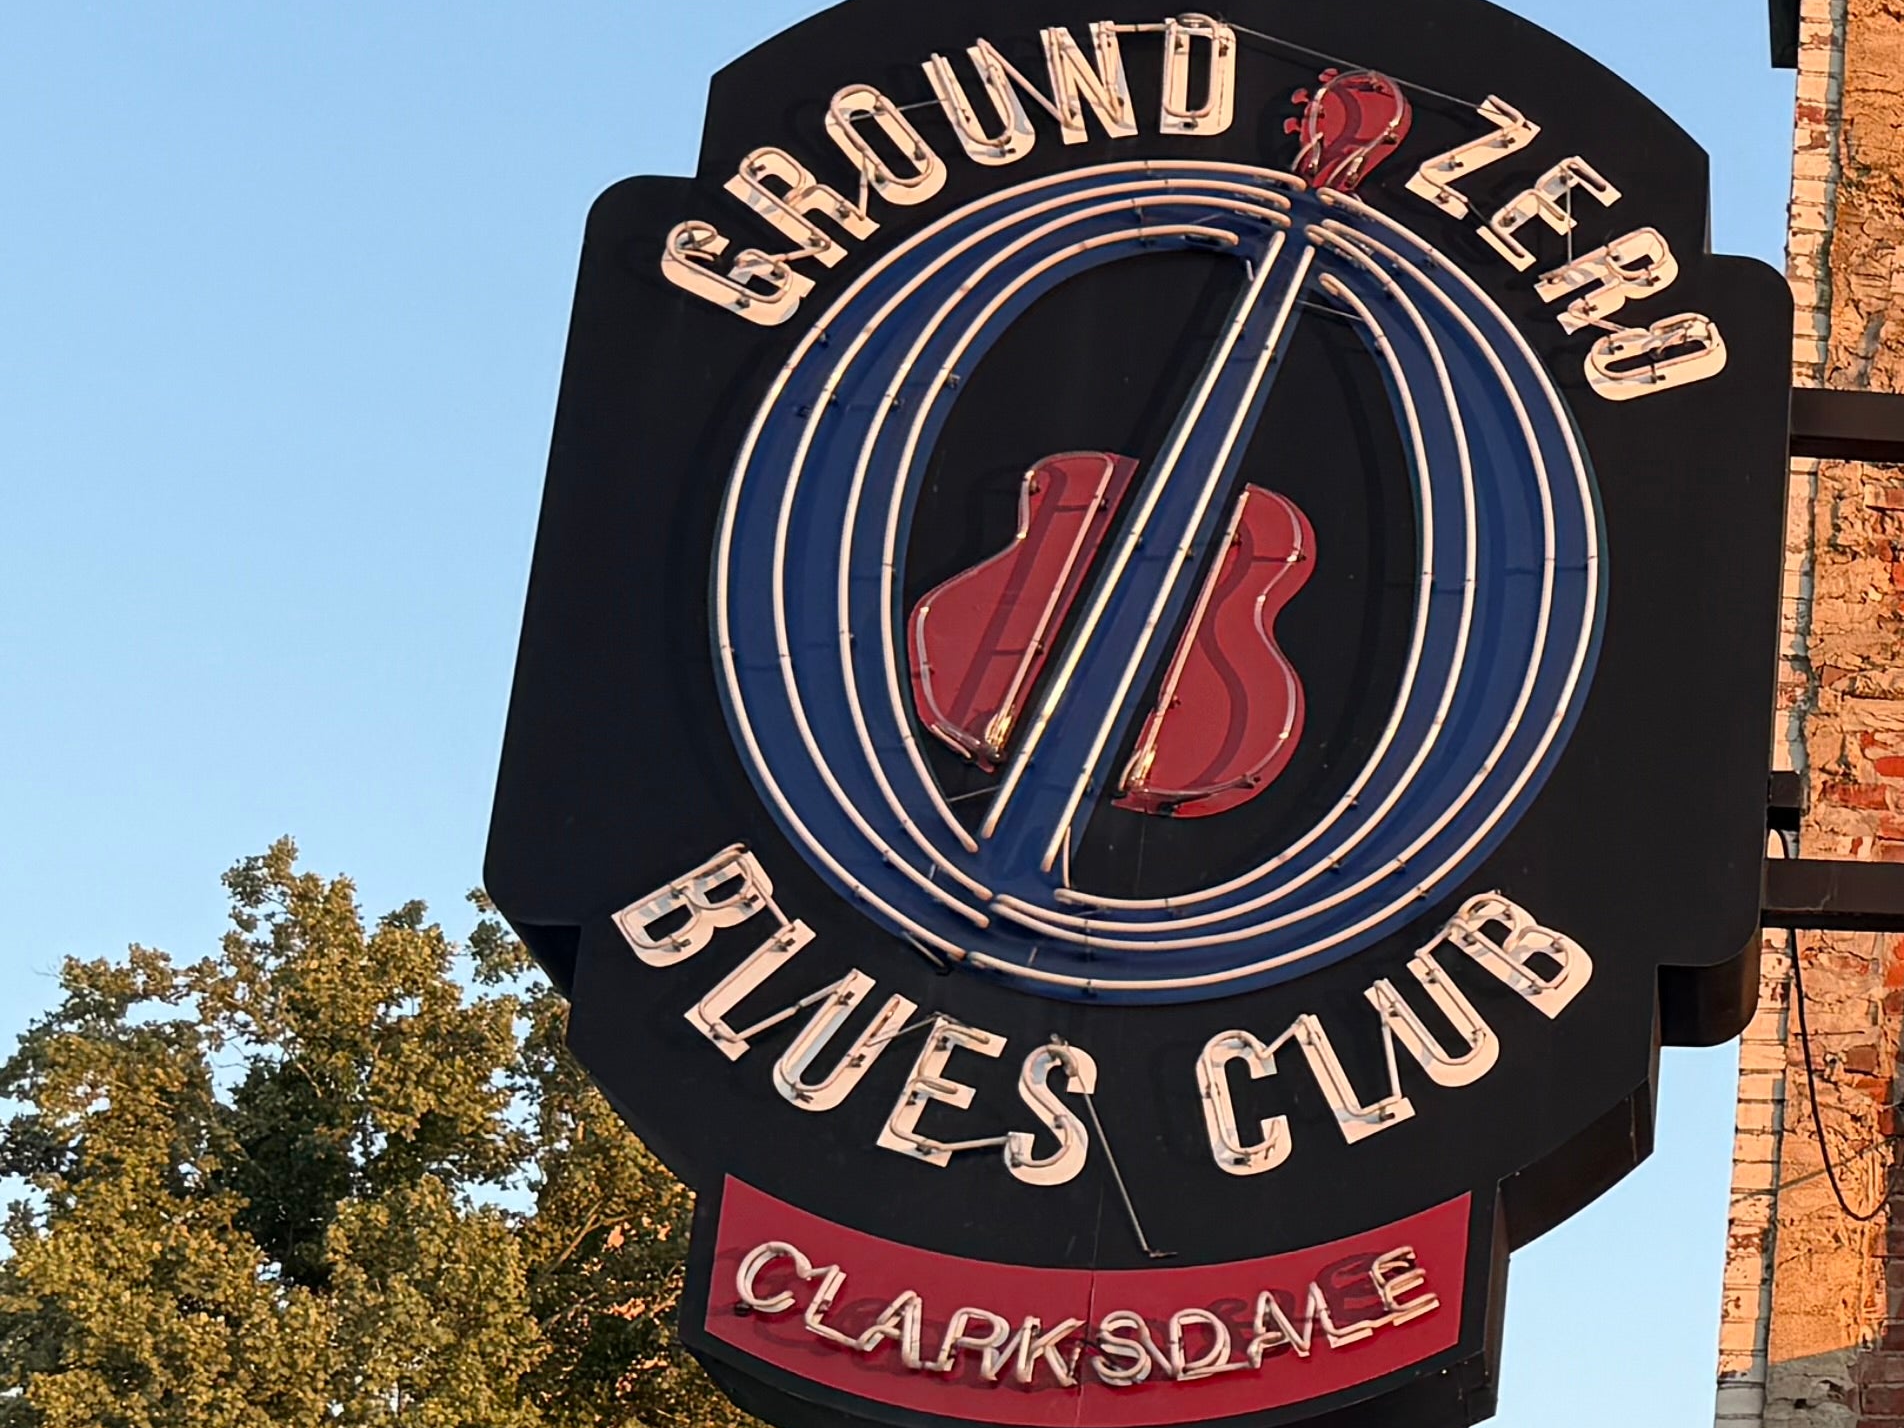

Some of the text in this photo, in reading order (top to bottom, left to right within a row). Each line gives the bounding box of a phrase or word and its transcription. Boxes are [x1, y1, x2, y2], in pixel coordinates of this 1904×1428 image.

[661, 12, 1728, 401] GROUND ZERO
[611, 843, 1593, 1186] BLUES CLUB
[735, 1240, 1440, 1387] CLARKSDALE
